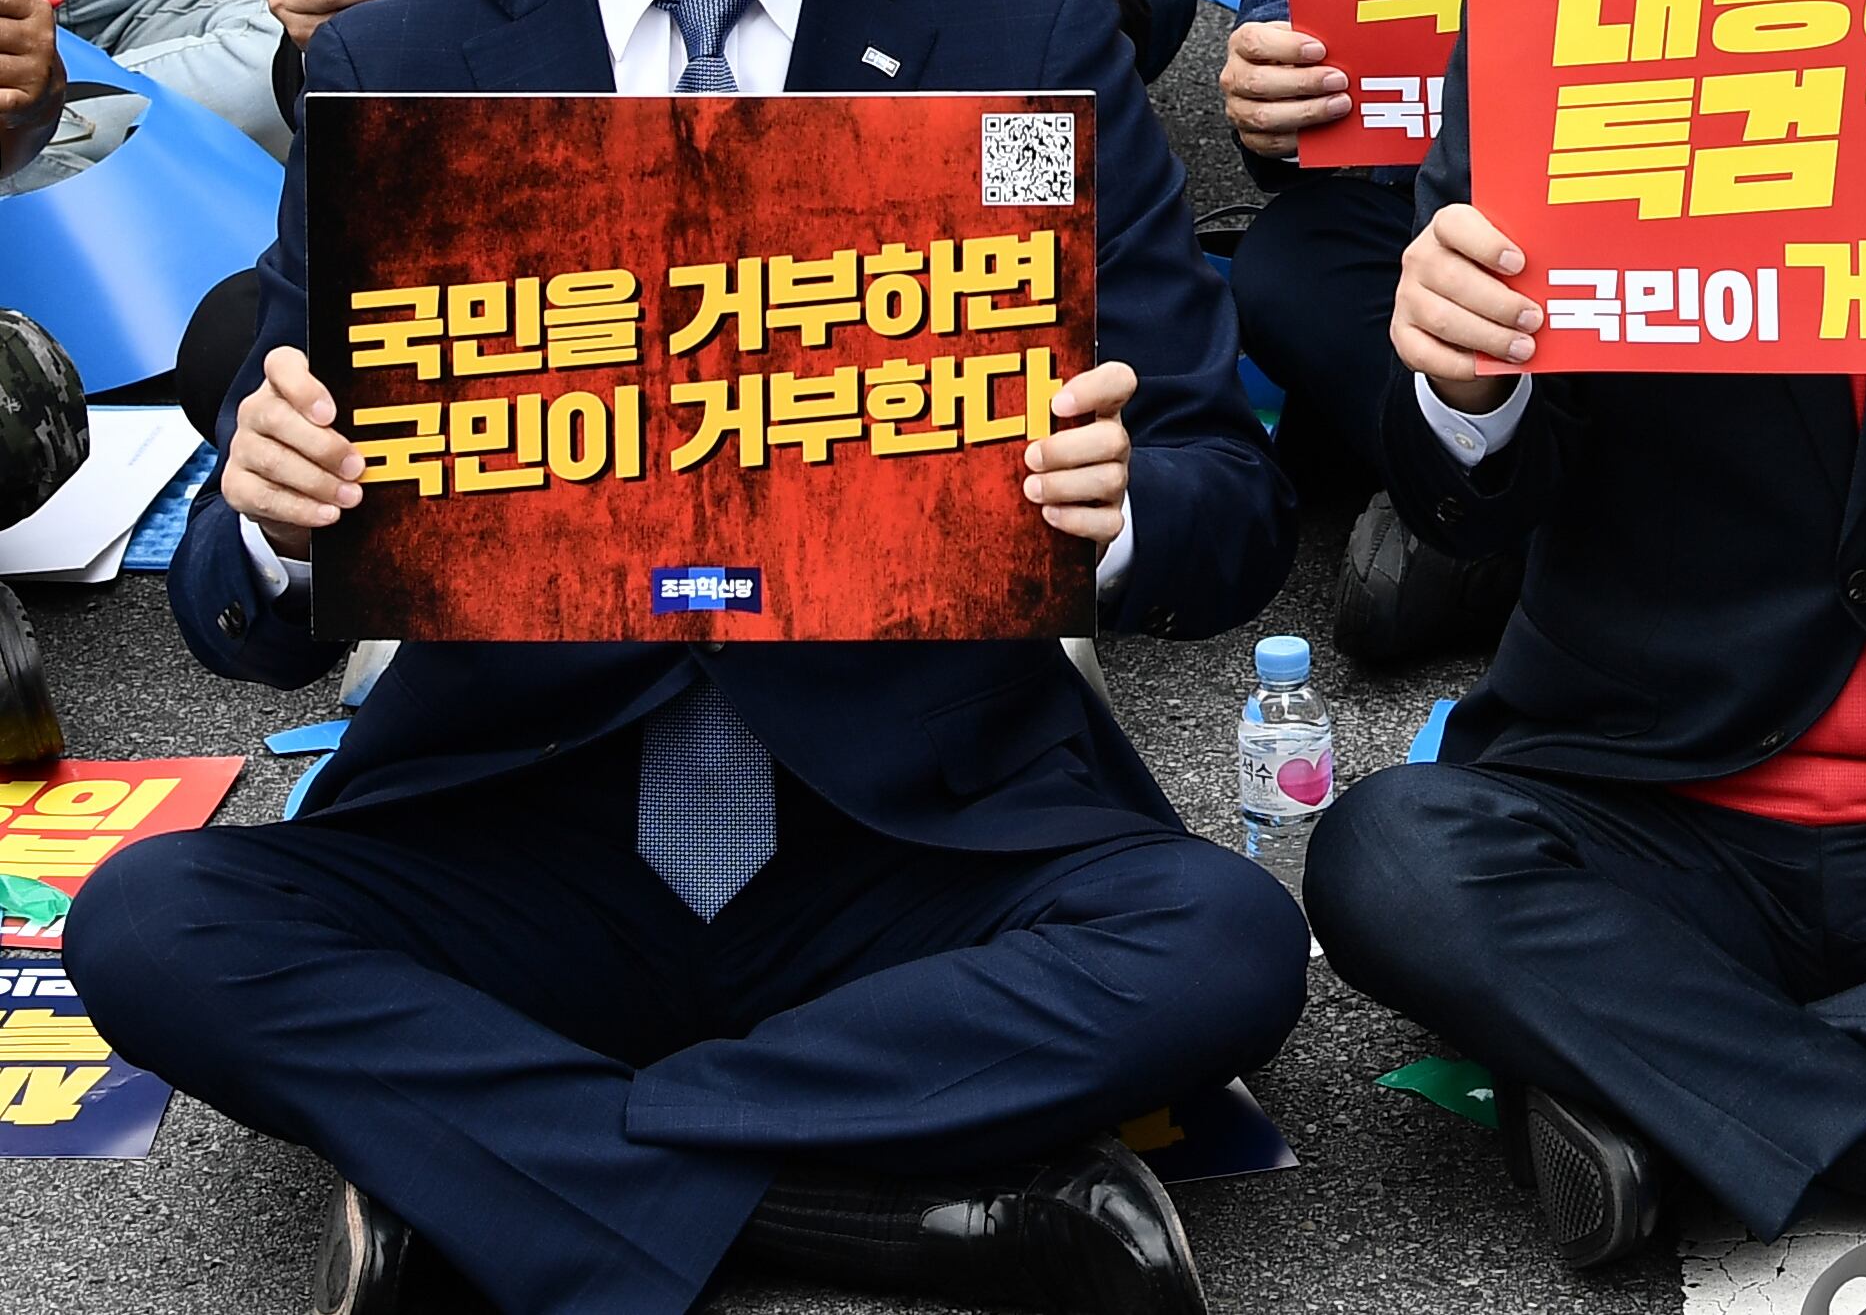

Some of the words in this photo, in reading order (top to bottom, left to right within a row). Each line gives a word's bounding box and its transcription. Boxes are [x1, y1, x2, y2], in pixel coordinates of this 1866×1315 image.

[1547, 66, 1847, 221] 특검
[348, 267, 643, 381] 국민을
[668, 229, 1059, 359] 거부하면
[1546, 266, 1780, 345] 국민이
[351, 386, 641, 498] 국민이
[670, 347, 1064, 473] 거부한다
[660, 575, 753, 601] 조국혁신당
